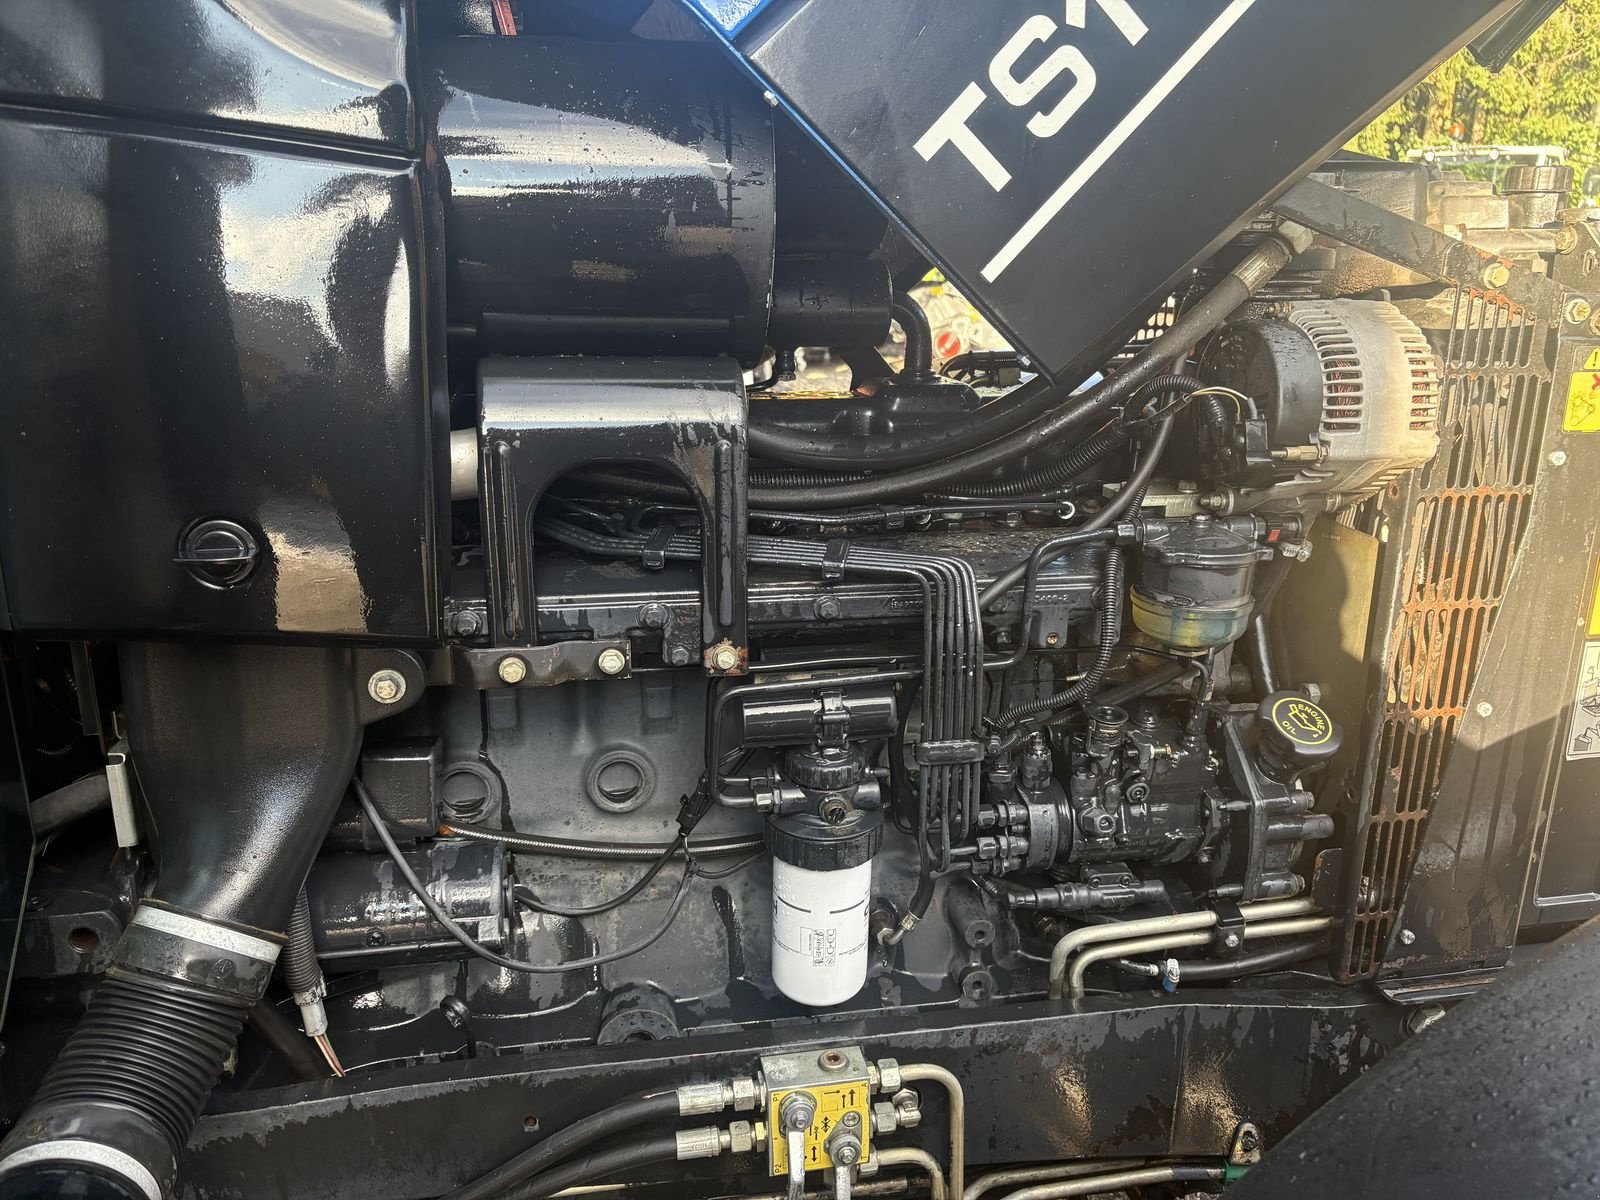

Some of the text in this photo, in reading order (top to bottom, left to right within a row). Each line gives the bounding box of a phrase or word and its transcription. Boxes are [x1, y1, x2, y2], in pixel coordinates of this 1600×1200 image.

[1298, 703, 1325, 731] ENGINE
[1282, 720, 1296, 735] OIL
[773, 1093, 780, 1102] P1
[774, 1163, 782, 1173] P2
